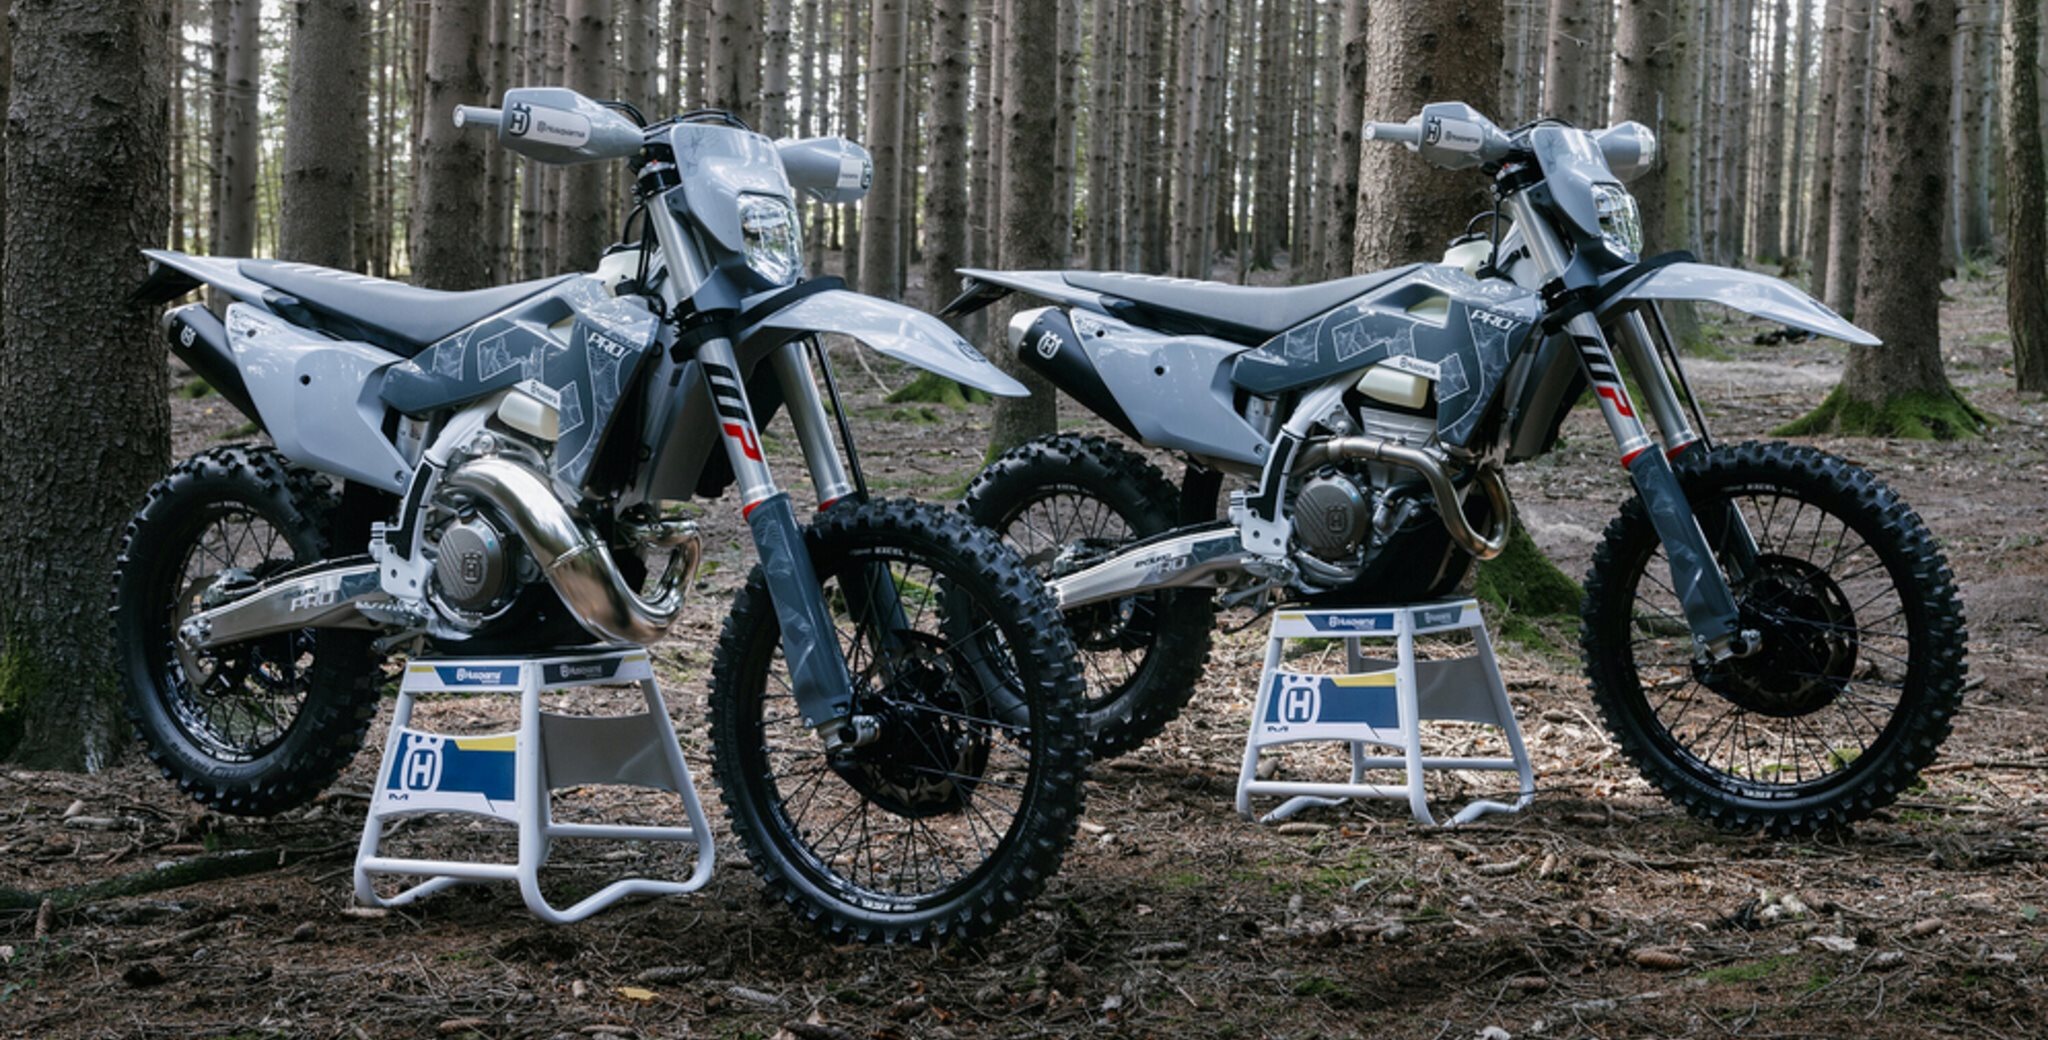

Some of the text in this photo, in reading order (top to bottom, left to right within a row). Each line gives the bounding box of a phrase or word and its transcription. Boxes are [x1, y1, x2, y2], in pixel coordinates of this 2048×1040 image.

[1471, 309, 1514, 330] PRO
[588, 332, 625, 358] PRO
[290, 591, 335, 612] PRO
